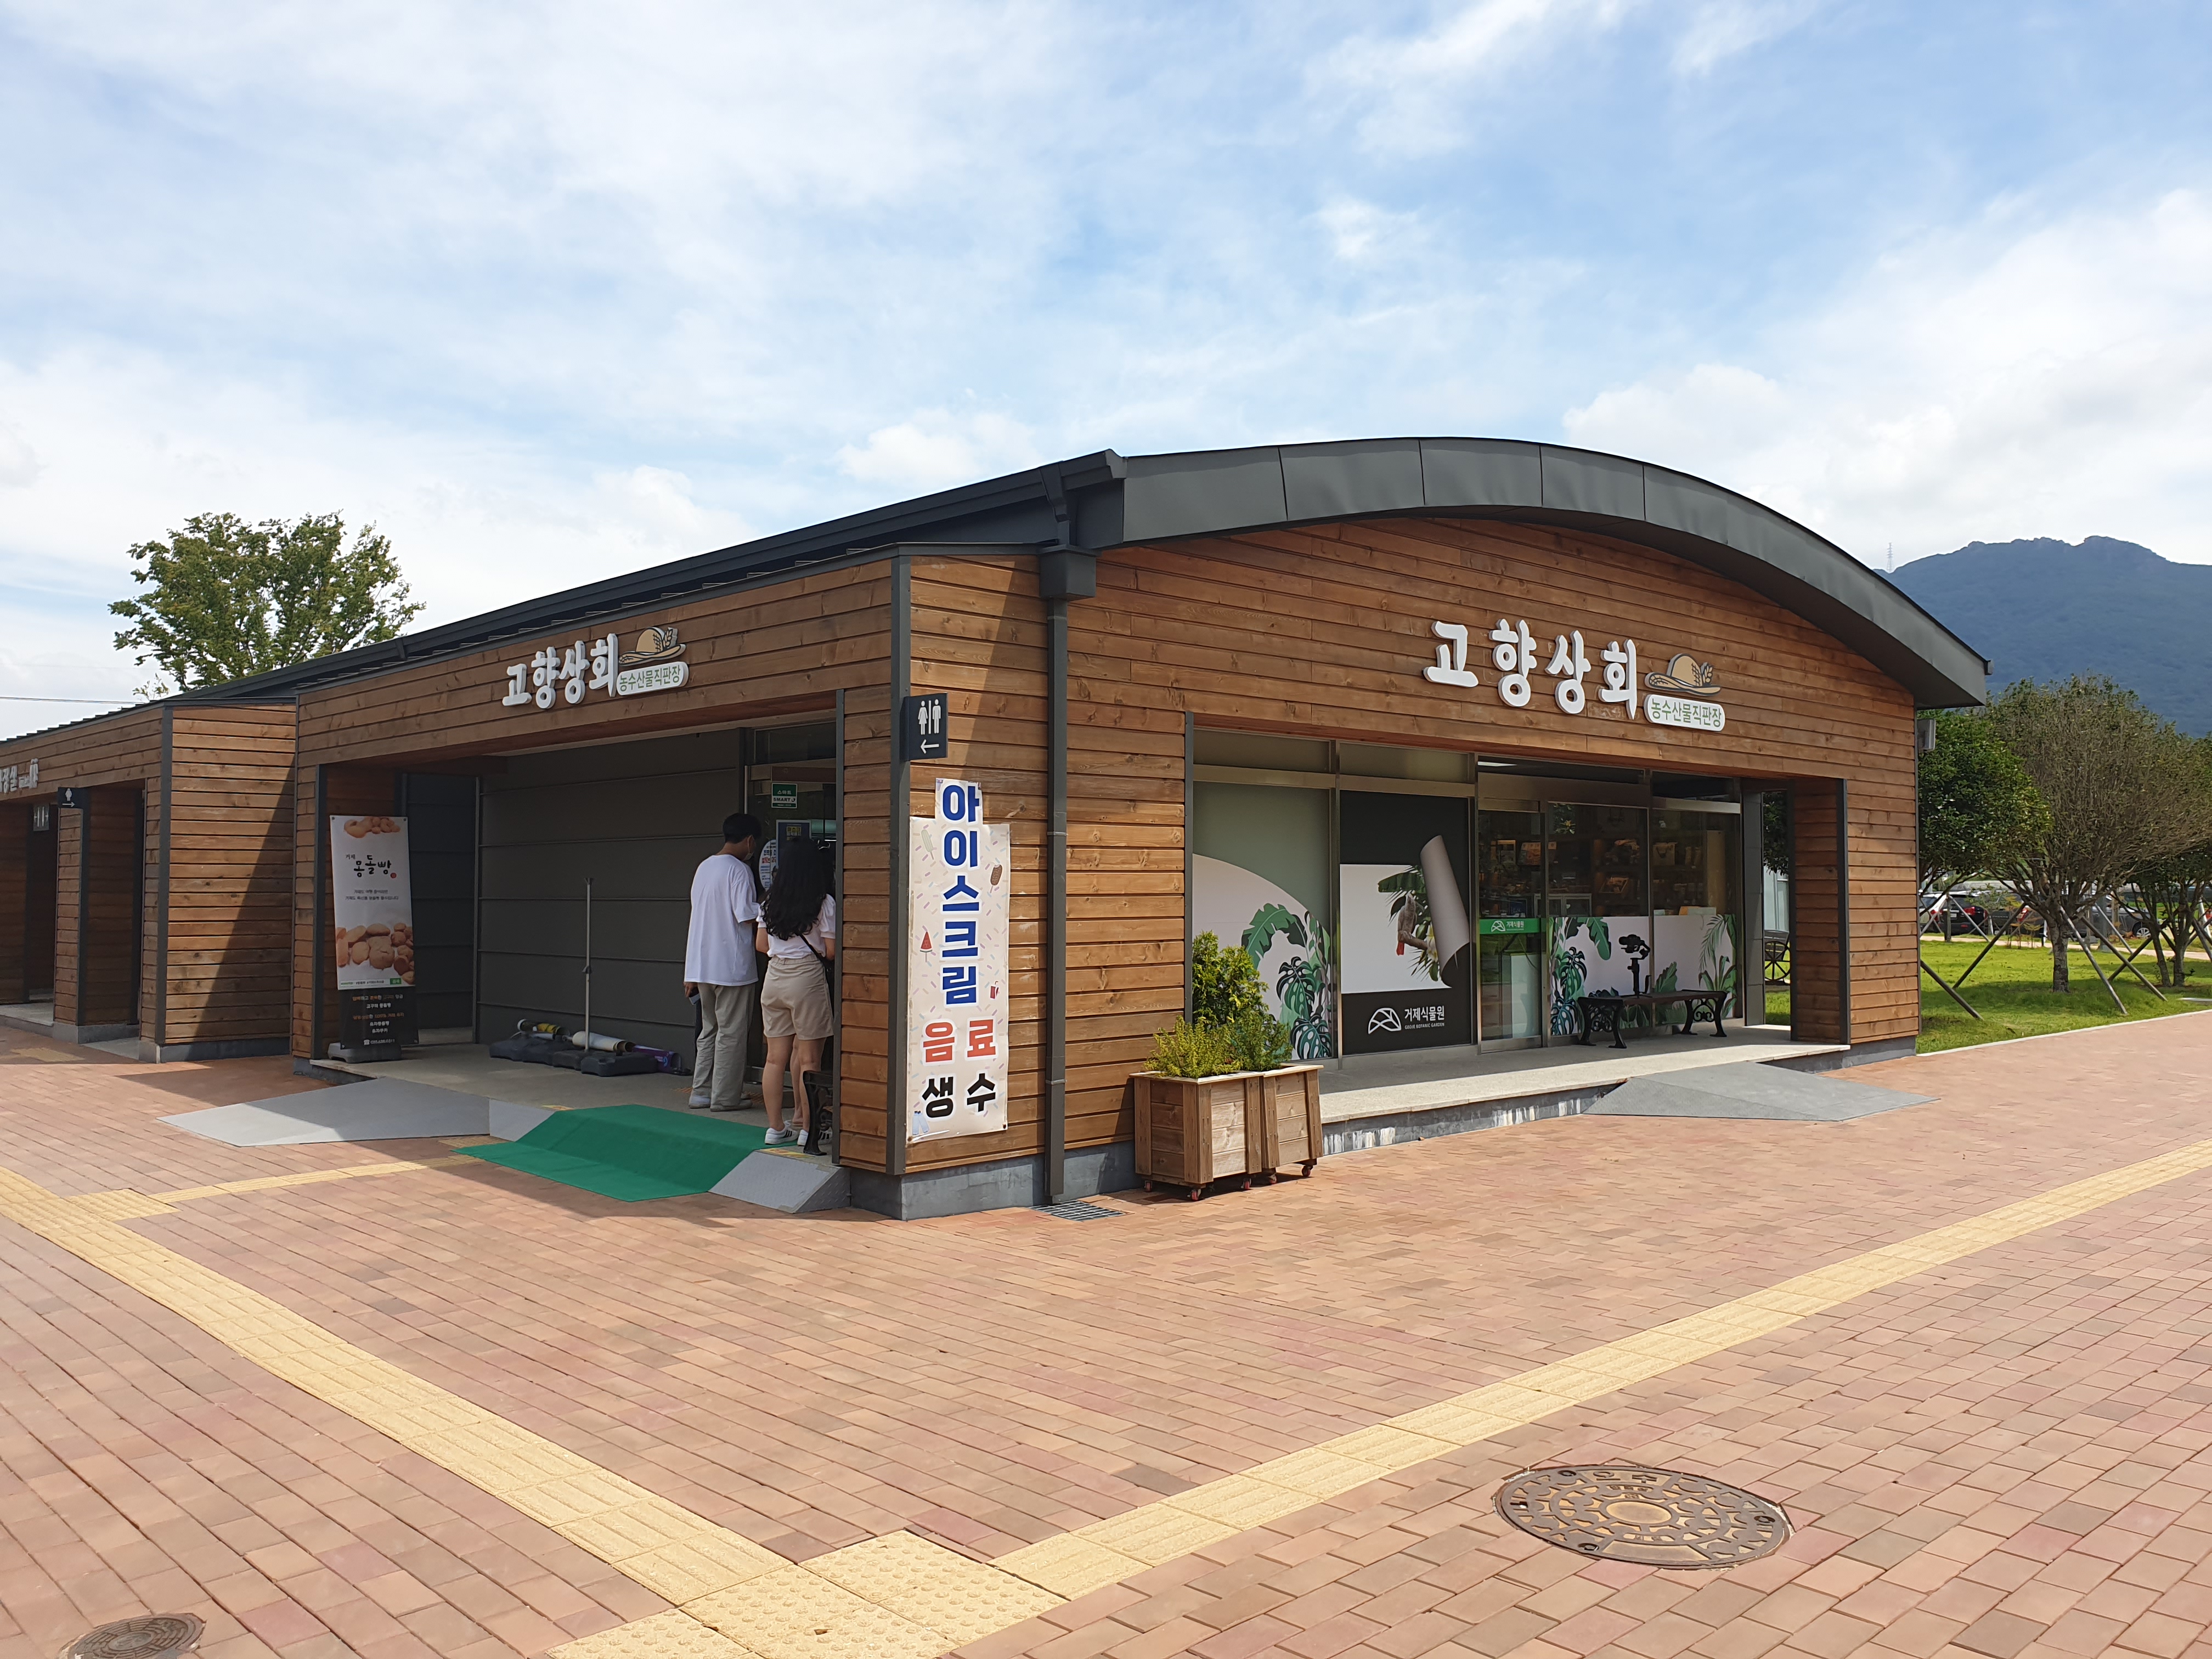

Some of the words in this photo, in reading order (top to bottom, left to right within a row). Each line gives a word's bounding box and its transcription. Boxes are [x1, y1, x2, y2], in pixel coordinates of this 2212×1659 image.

[502, 633, 619, 709] 고향상회
[619, 664, 681, 692] 농수산물직판장
[1424, 619, 1638, 720] 고향상회
[1651, 697, 1722, 728] 농수산물직판장
[353, 855, 392, 878] 몽돌빵
[942, 785, 980, 1005] 아이스크림
[1404, 1005, 1444, 1022] 거제식물원
[923, 1019, 996, 1063] 음료
[922, 1073, 996, 1118] 생수
[1593, 1471, 1658, 1483] 오수
